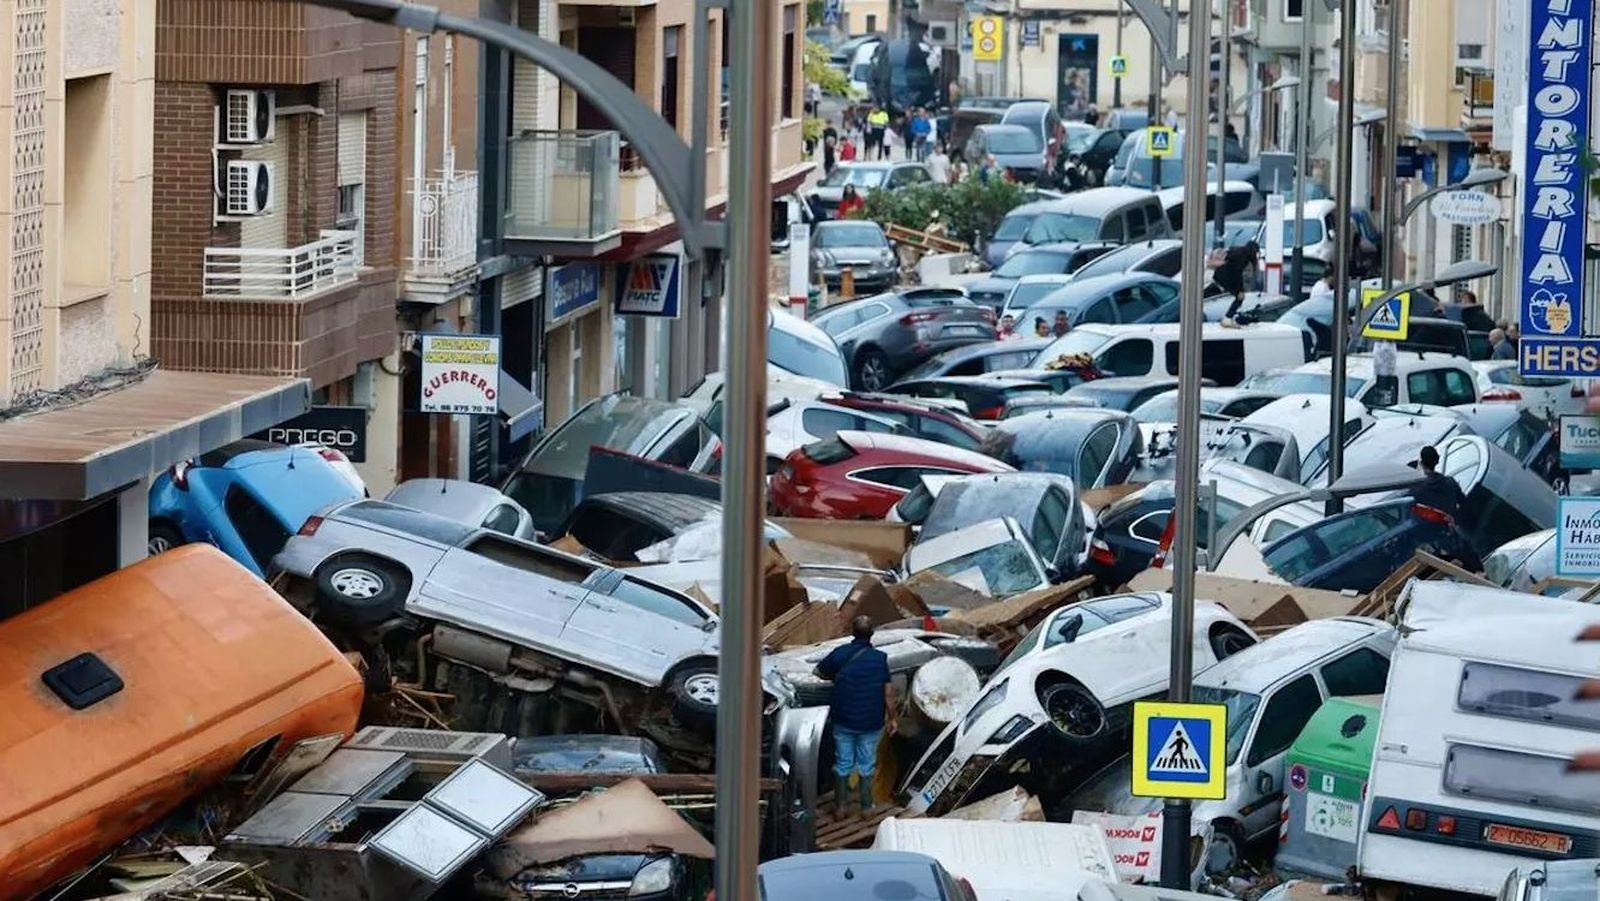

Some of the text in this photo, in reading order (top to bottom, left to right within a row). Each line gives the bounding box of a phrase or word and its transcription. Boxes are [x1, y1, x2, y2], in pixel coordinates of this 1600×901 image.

[1524, 345, 1598, 372] HERS
[424, 370, 496, 400] GUERRERO
[269, 428, 355, 446] PREGO
[1114, 854, 1135, 864] ROC
